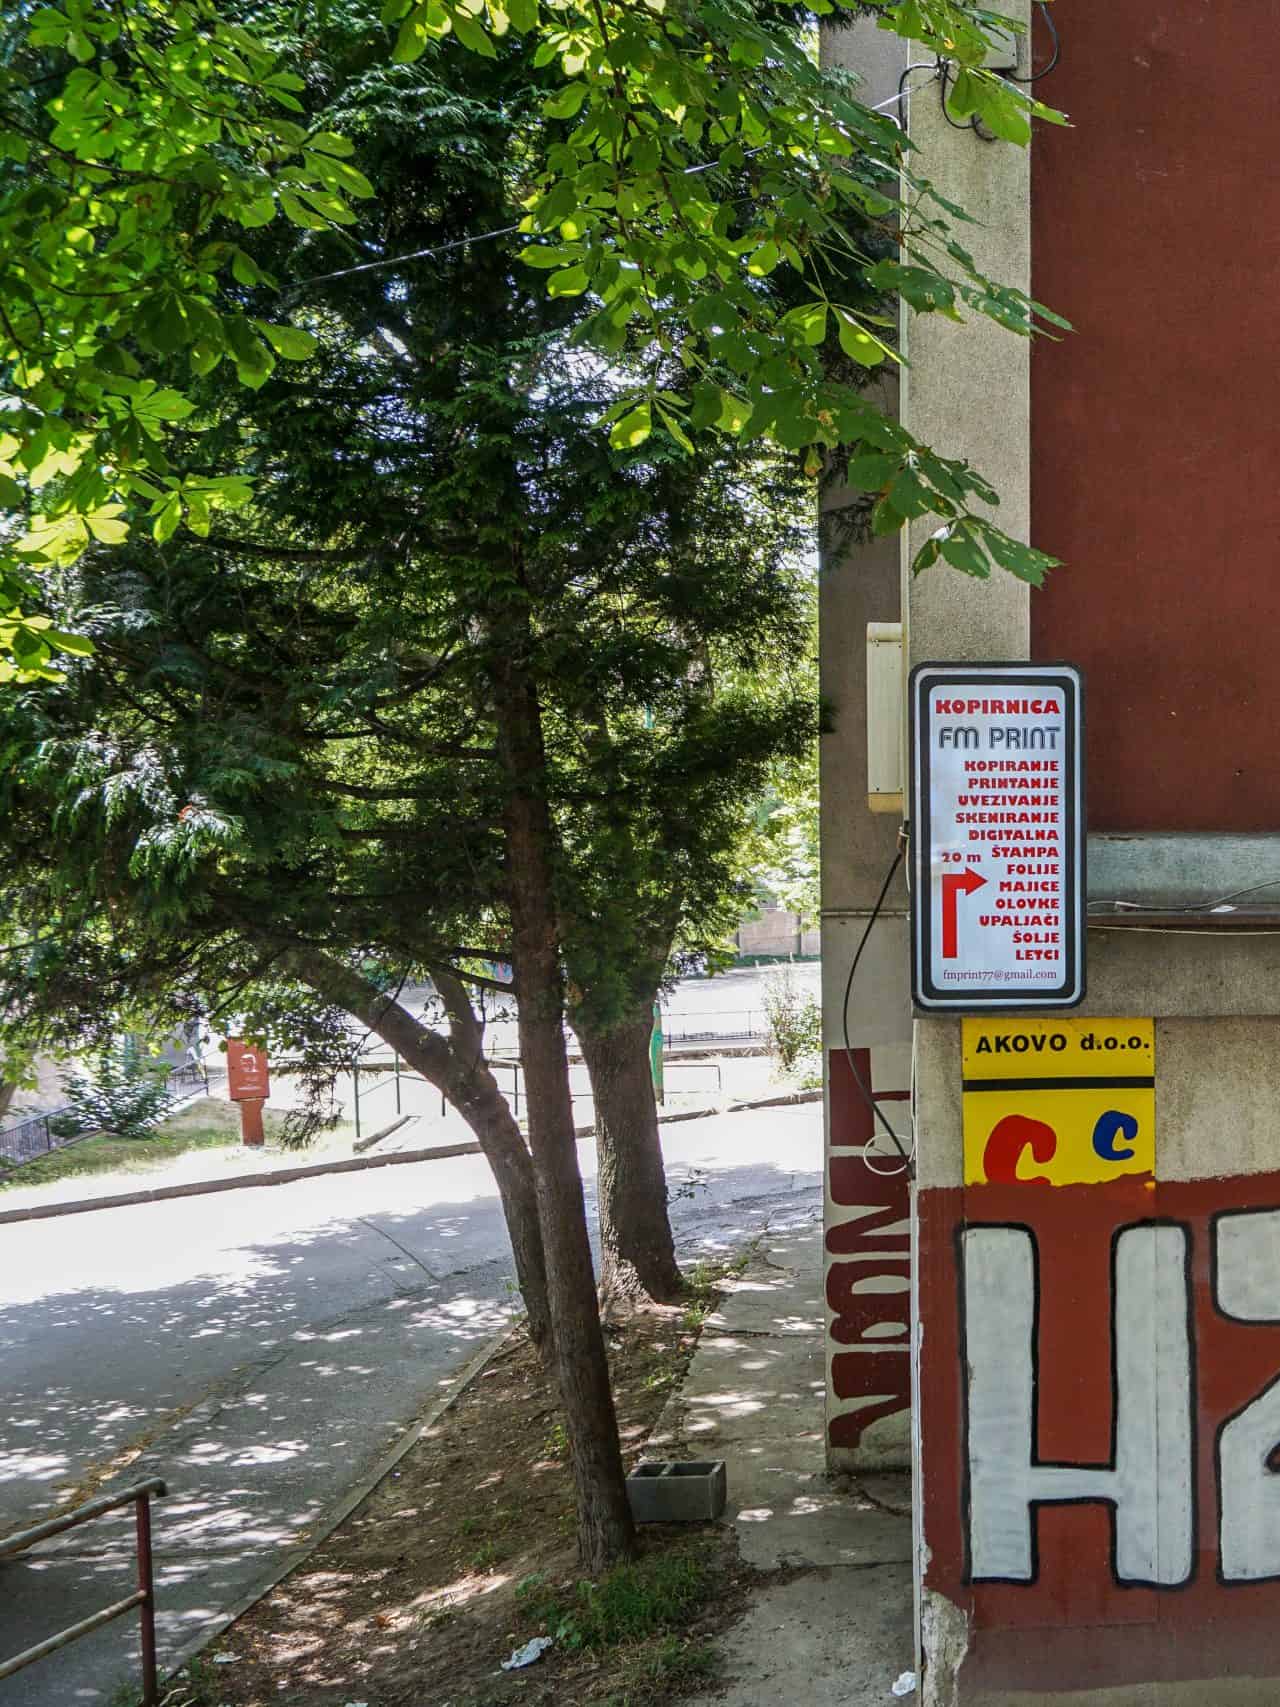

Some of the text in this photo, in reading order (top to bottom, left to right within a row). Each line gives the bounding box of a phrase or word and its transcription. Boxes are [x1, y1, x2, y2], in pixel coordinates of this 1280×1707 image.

[936, 699, 1060, 714] KOPIRNICA
[964, 760, 1059, 772] KOPIRANJE
[968, 778, 1059, 789] PRINTANJE
[957, 795, 1059, 806] UVEZIVANJE
[955, 812, 1059, 824] SKENIRANJE
[968, 829, 1059, 841] DIGITALNA
[941, 852, 982, 863] 20 m
[991, 845, 1059, 858] ŠTAMPA
[1007, 864, 1059, 875] FOLIJE
[999, 881, 1059, 892] MAJICE
[995, 898, 1059, 909] OLOVKE
[979, 913, 1059, 926] UPALJAČI
[1012, 930, 1059, 943] ŠOLJE
[1015, 949, 1059, 960] LETCI
[943, 968, 1057, 982] fmprint77@gmail.com
[976, 1033, 1149, 1054] AKOVO d.o.o.
